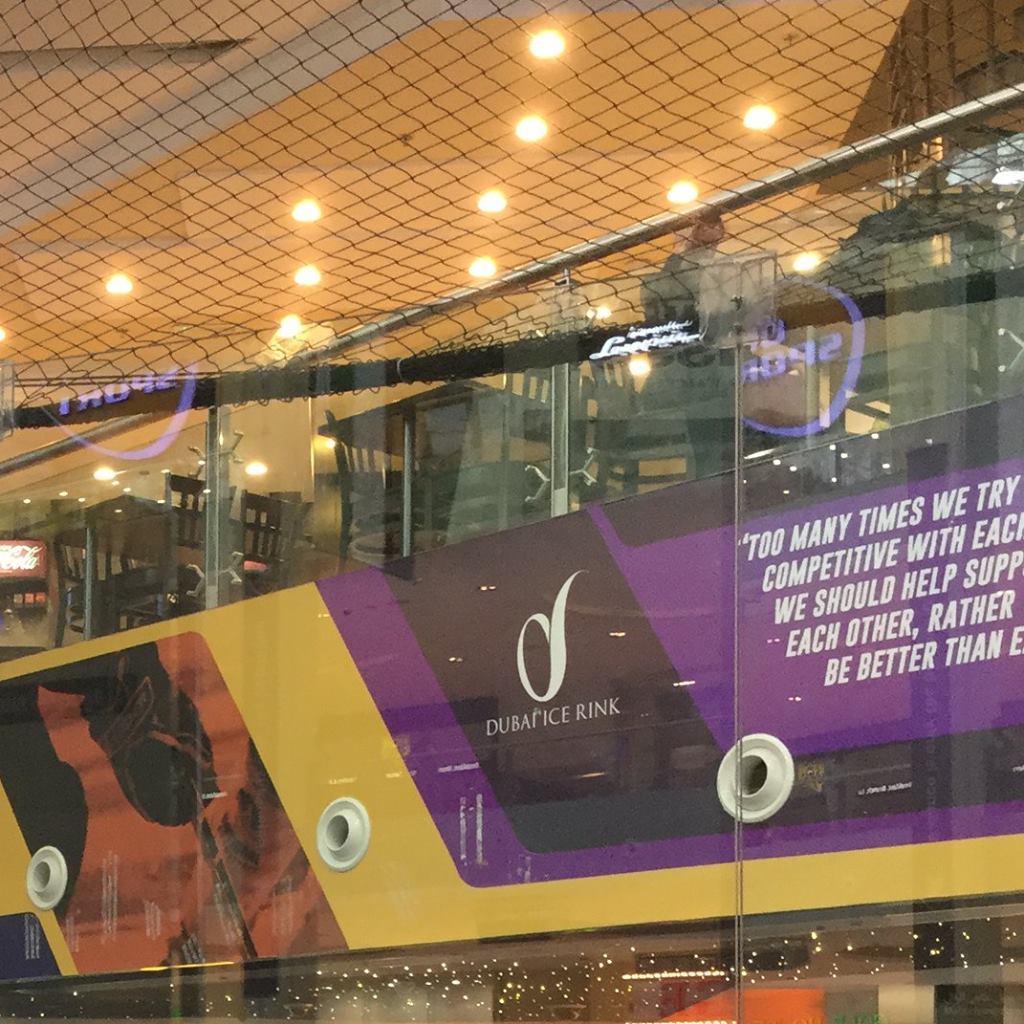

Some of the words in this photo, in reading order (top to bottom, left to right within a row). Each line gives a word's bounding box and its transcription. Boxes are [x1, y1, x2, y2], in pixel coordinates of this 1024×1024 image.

[789, 513, 852, 552] MANY
[858, 496, 925, 537] TIMES
[932, 486, 970, 521] WE
[976, 475, 1022, 512] TRY
[762, 538, 901, 592] COMPETITIVE
[907, 524, 967, 562] WITH
[775, 597, 810, 625] WE
[813, 575, 896, 618] SHOULD
[901, 563, 958, 600] HELP
[963, 550, 1024, 589] SUPP
[785, 622, 841, 657] EACH
[845, 608, 920, 647] OTHER,
[927, 589, 1016, 633] RATHER
[824, 657, 853, 687] BE
[856, 640, 938, 681] BETTER
[945, 629, 1004, 666] THAN
[1009, 626, 1024, 656] E
[486, 711, 539, 736] DUBAI
[543, 706, 570, 726] ICE
[576, 697, 621, 721] RINK
